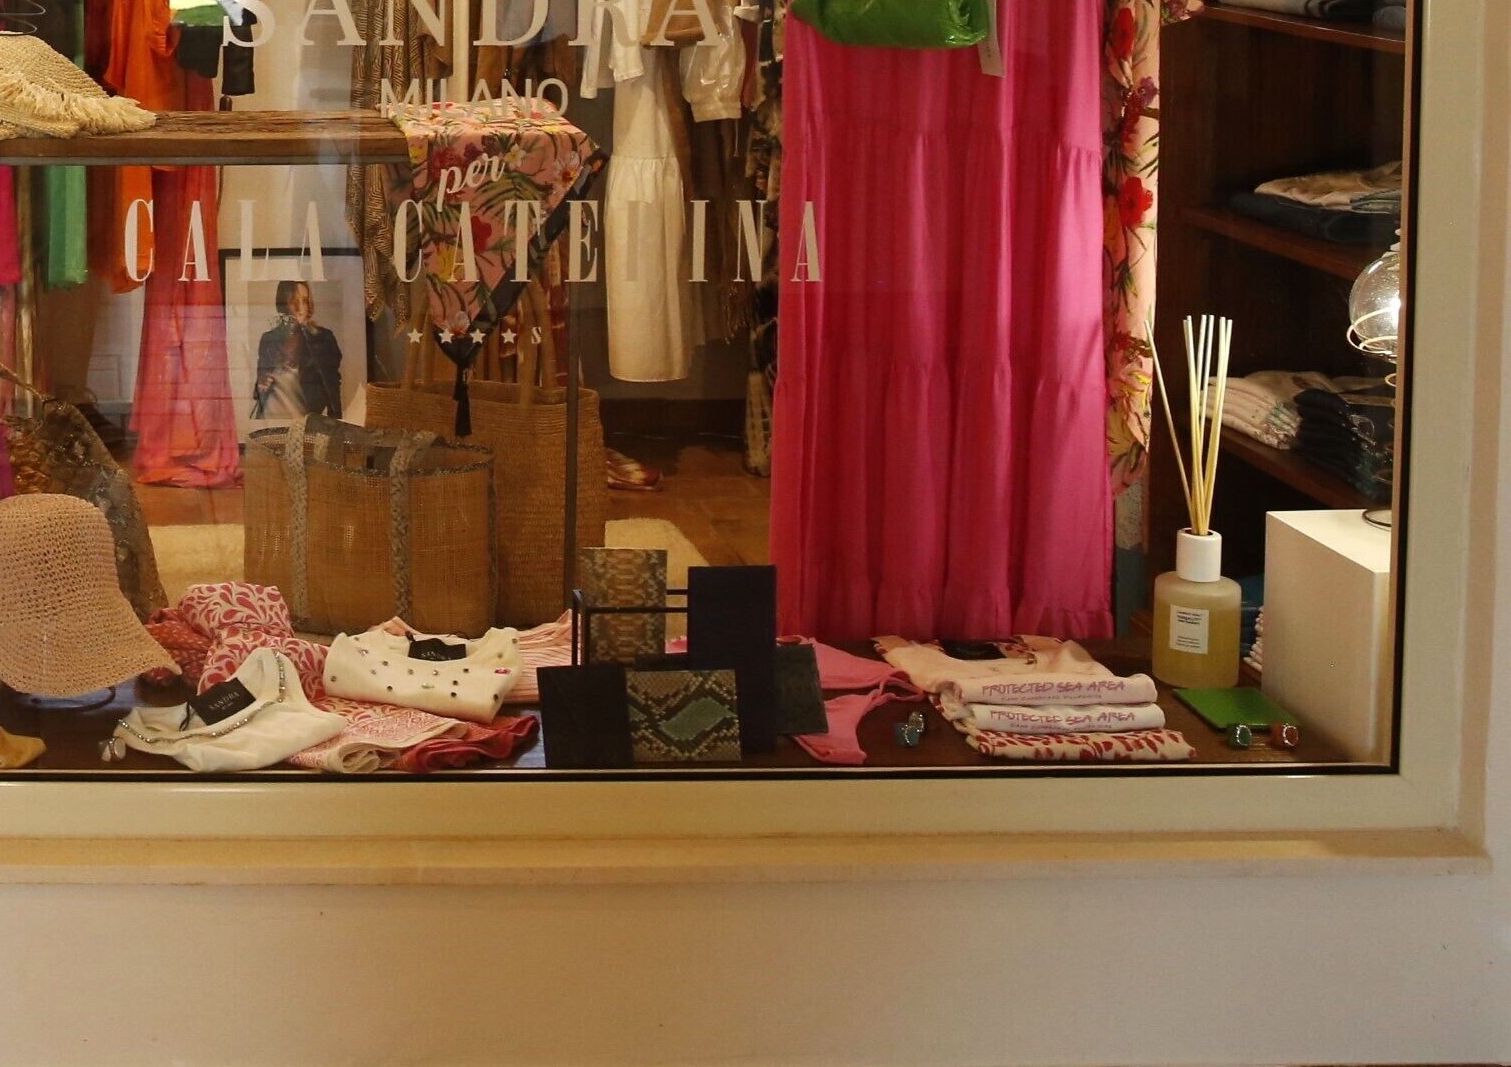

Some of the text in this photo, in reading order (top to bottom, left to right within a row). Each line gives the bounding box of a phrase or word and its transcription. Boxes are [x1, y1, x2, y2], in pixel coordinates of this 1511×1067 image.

[380, 78, 569, 119] MILANO
[436, 152, 506, 212] per
[124, 198, 328, 282] CALA
[982, 680, 1126, 696] PROTECTED SEA AREA
[990, 710, 1136, 725] PROTECTED SEA AREA
